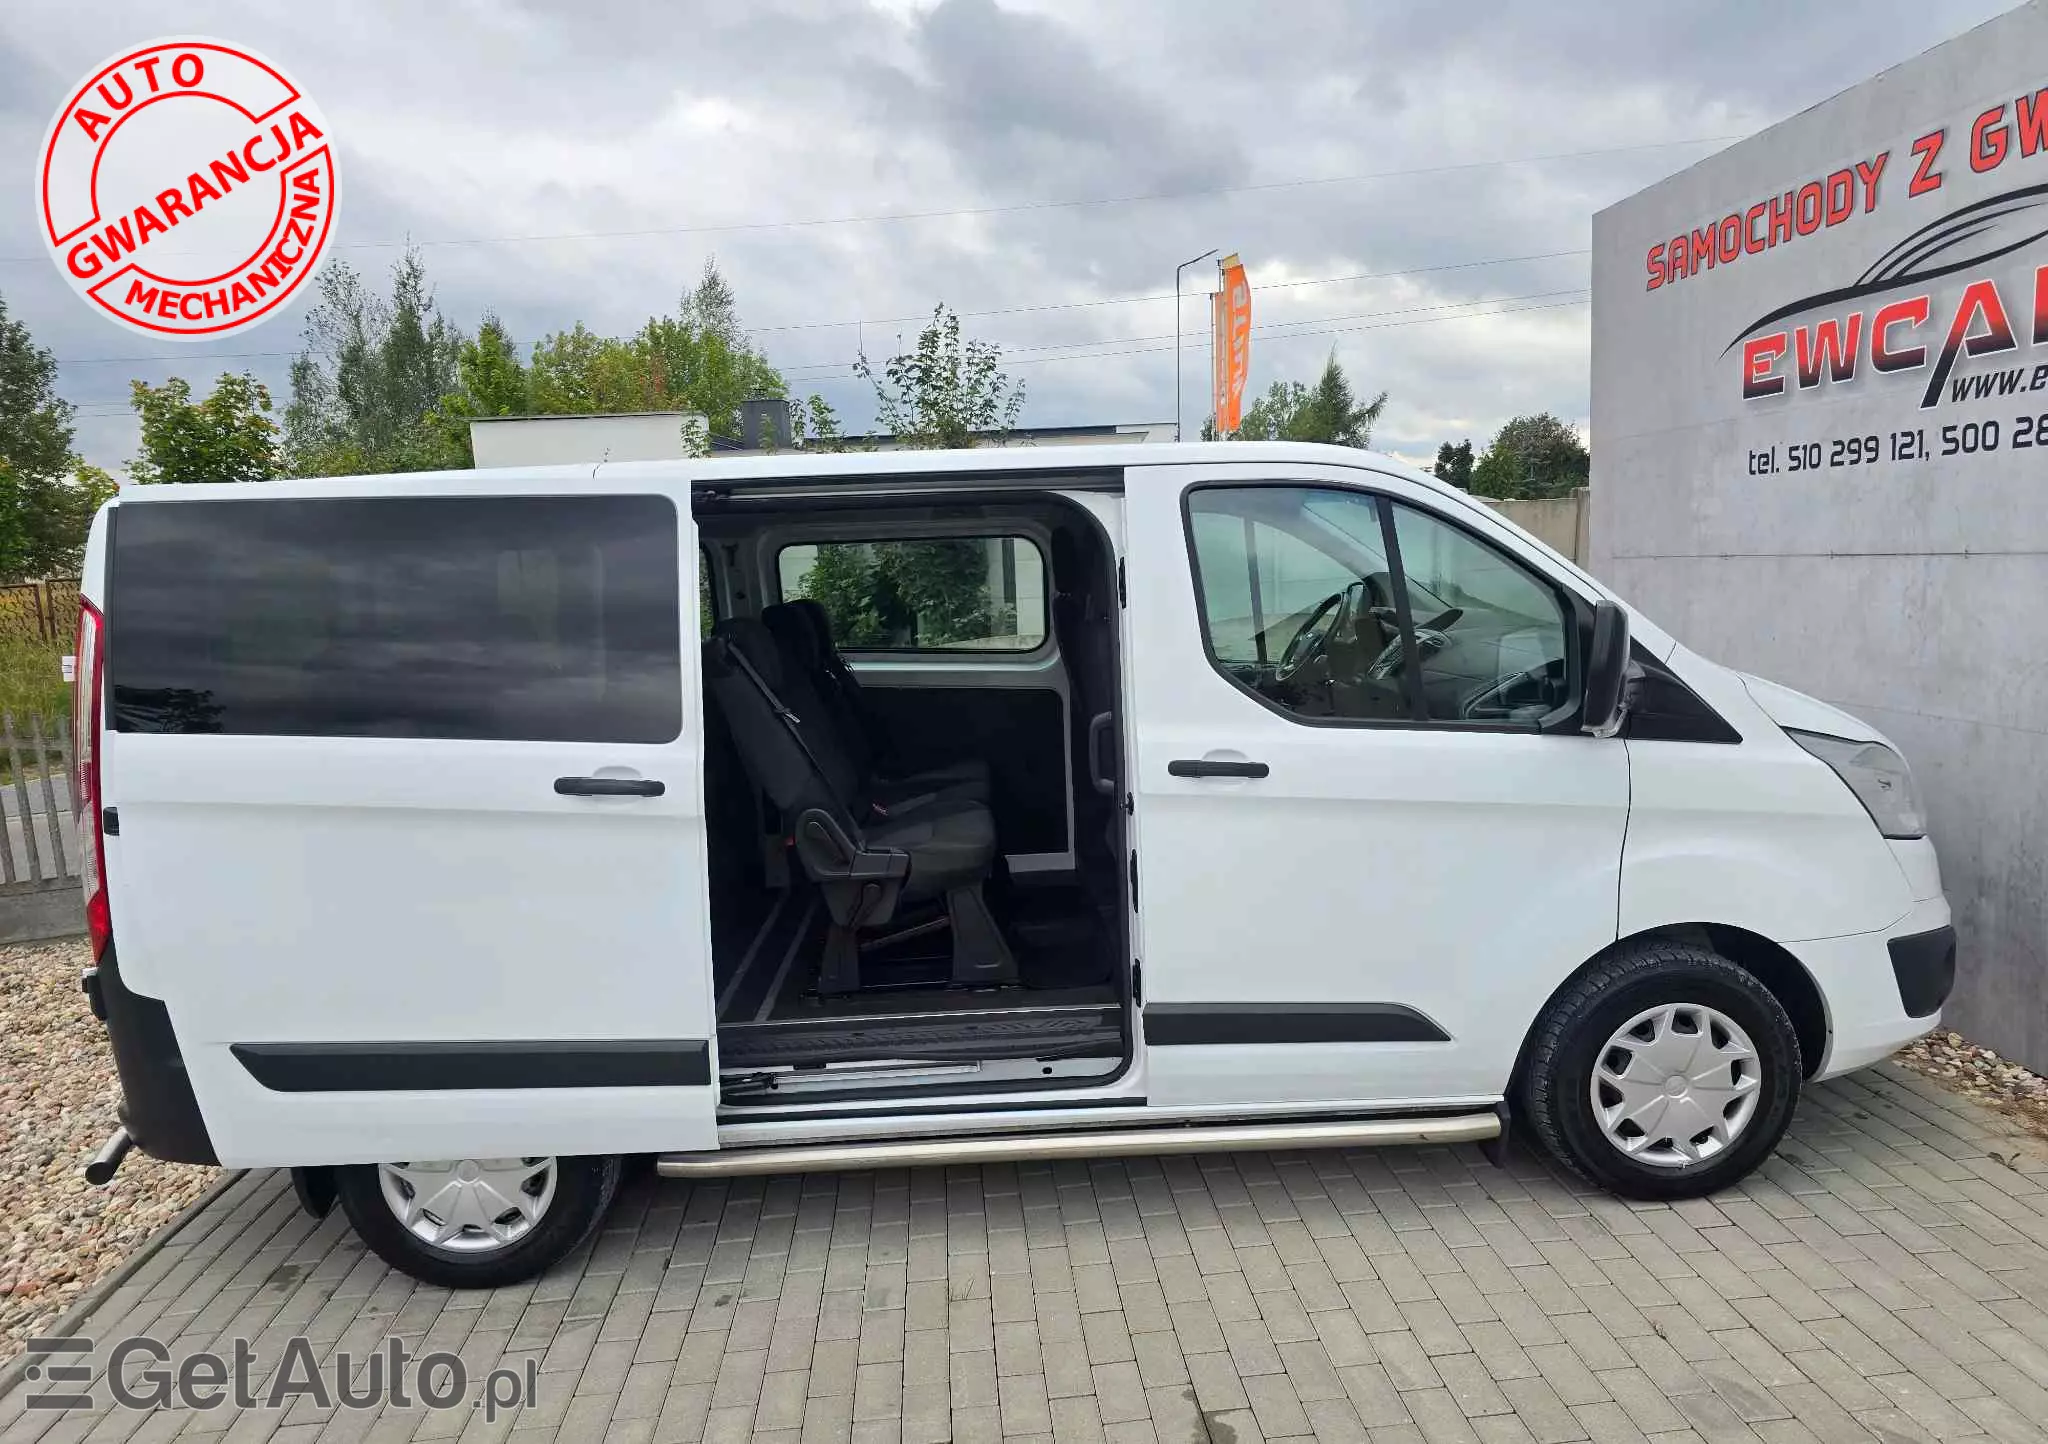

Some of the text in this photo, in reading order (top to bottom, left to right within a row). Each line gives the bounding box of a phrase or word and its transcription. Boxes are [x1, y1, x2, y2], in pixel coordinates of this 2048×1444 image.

[1646, 150, 1890, 291] SAMOCHODY
[1908, 129, 1945, 198] Z
[1749, 446, 1780, 476] tel.
[1788, 442, 1822, 472] 510
[1830, 435, 1880, 468] 299
[1890, 429, 1930, 462] 121,
[1941, 420, 2000, 456] 500
